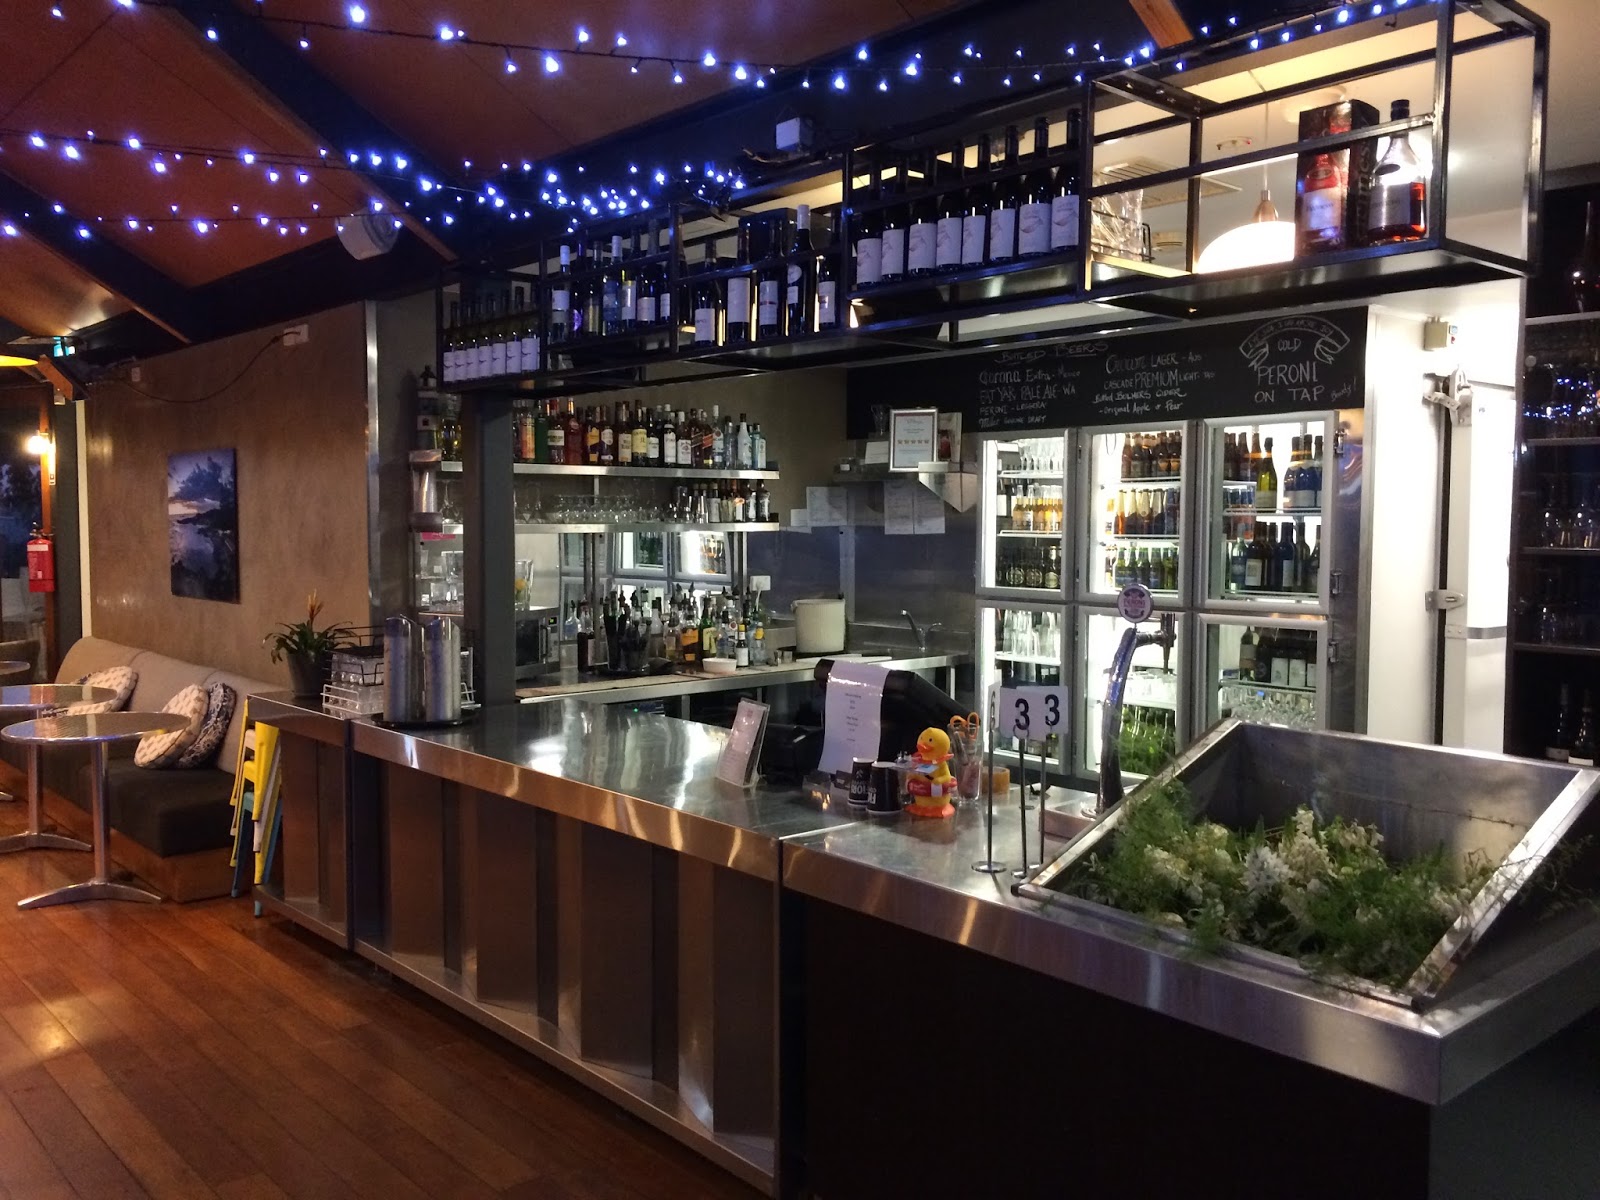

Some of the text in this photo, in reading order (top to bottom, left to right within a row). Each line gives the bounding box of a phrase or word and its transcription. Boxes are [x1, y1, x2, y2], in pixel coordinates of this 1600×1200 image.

[1278, 338, 1302, 352] COLD
[1151, 353, 1178, 368] LAGER
[979, 369, 1021, 386] Corona
[1103, 378, 1134, 390] CASCADE
[1134, 368, 1179, 389] PREMIUM
[1258, 361, 1318, 386] PERONI
[1020, 385, 1041, 400] PALE
[1255, 385, 1325, 403] ON TAP
[1015, 698, 1030, 730] 3
[1045, 694, 1060, 726] 3
